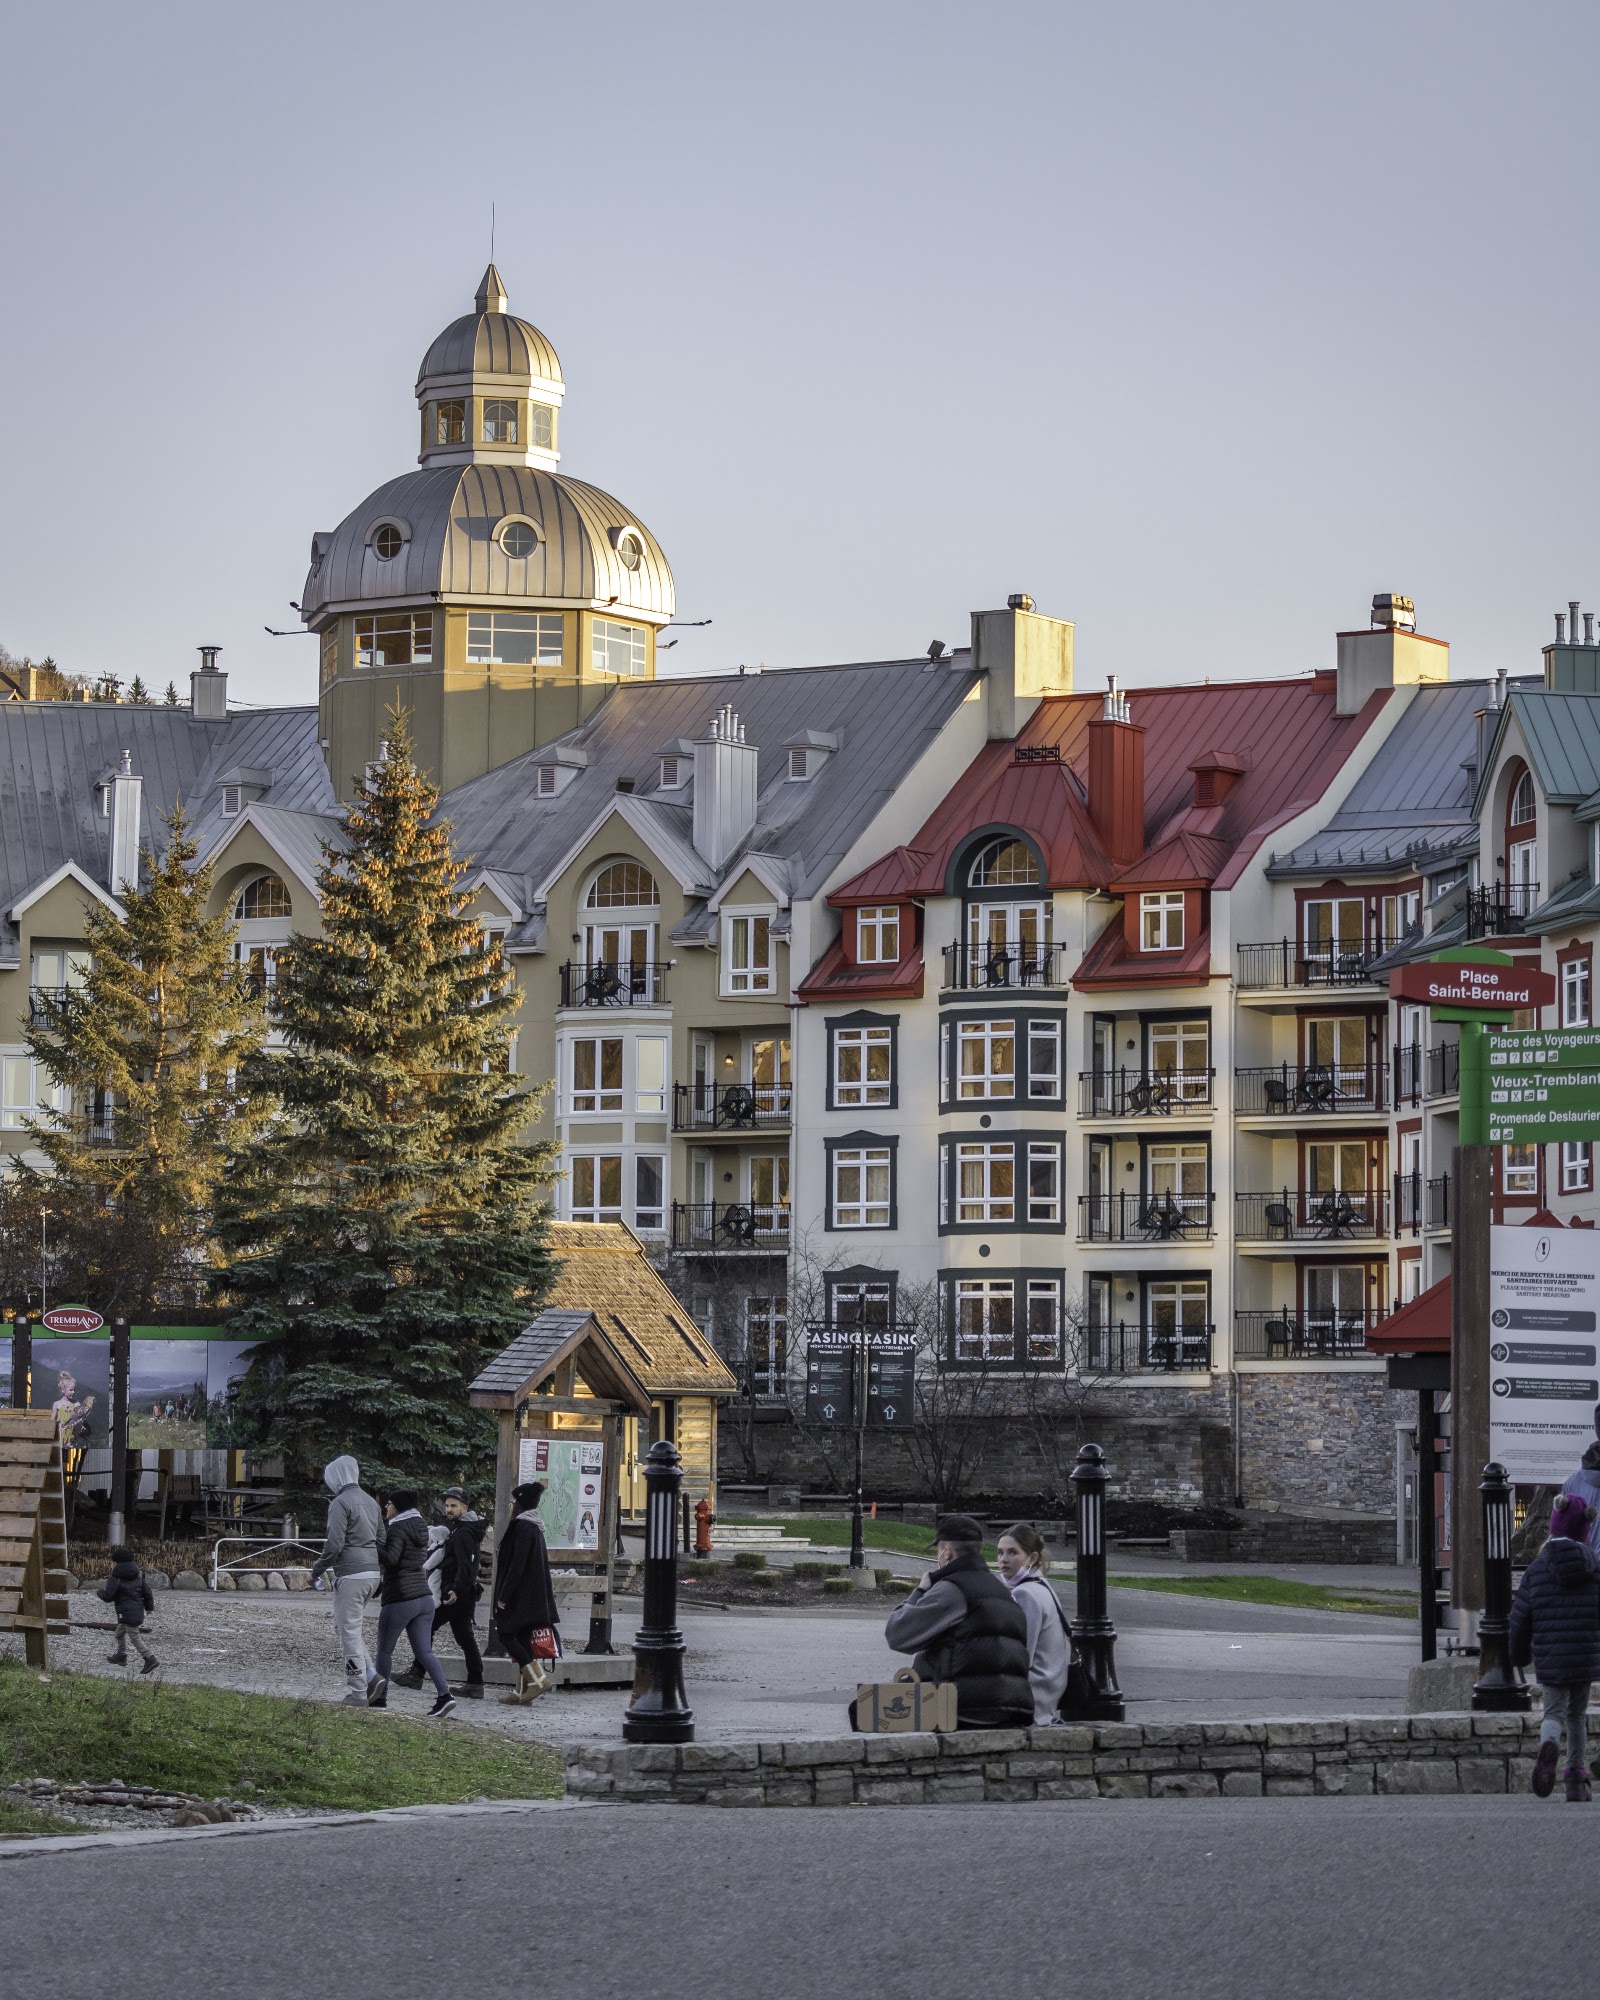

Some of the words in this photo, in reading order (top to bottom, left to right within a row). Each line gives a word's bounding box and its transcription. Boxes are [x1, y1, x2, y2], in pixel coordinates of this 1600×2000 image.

[1460, 970, 1499, 984] Place
[1429, 984, 1529, 1002] Saint-Bernard
[1490, 1036, 1519, 1049] Place
[1522, 1035, 1542, 1047] des
[1544, 1034, 1600, 1048] Voyageurs
[1491, 1072, 1600, 1088] Vieux-Tremblant
[1490, 1111, 1547, 1124] Promenade
[49, 1316, 99, 1327] TREMBLANT
